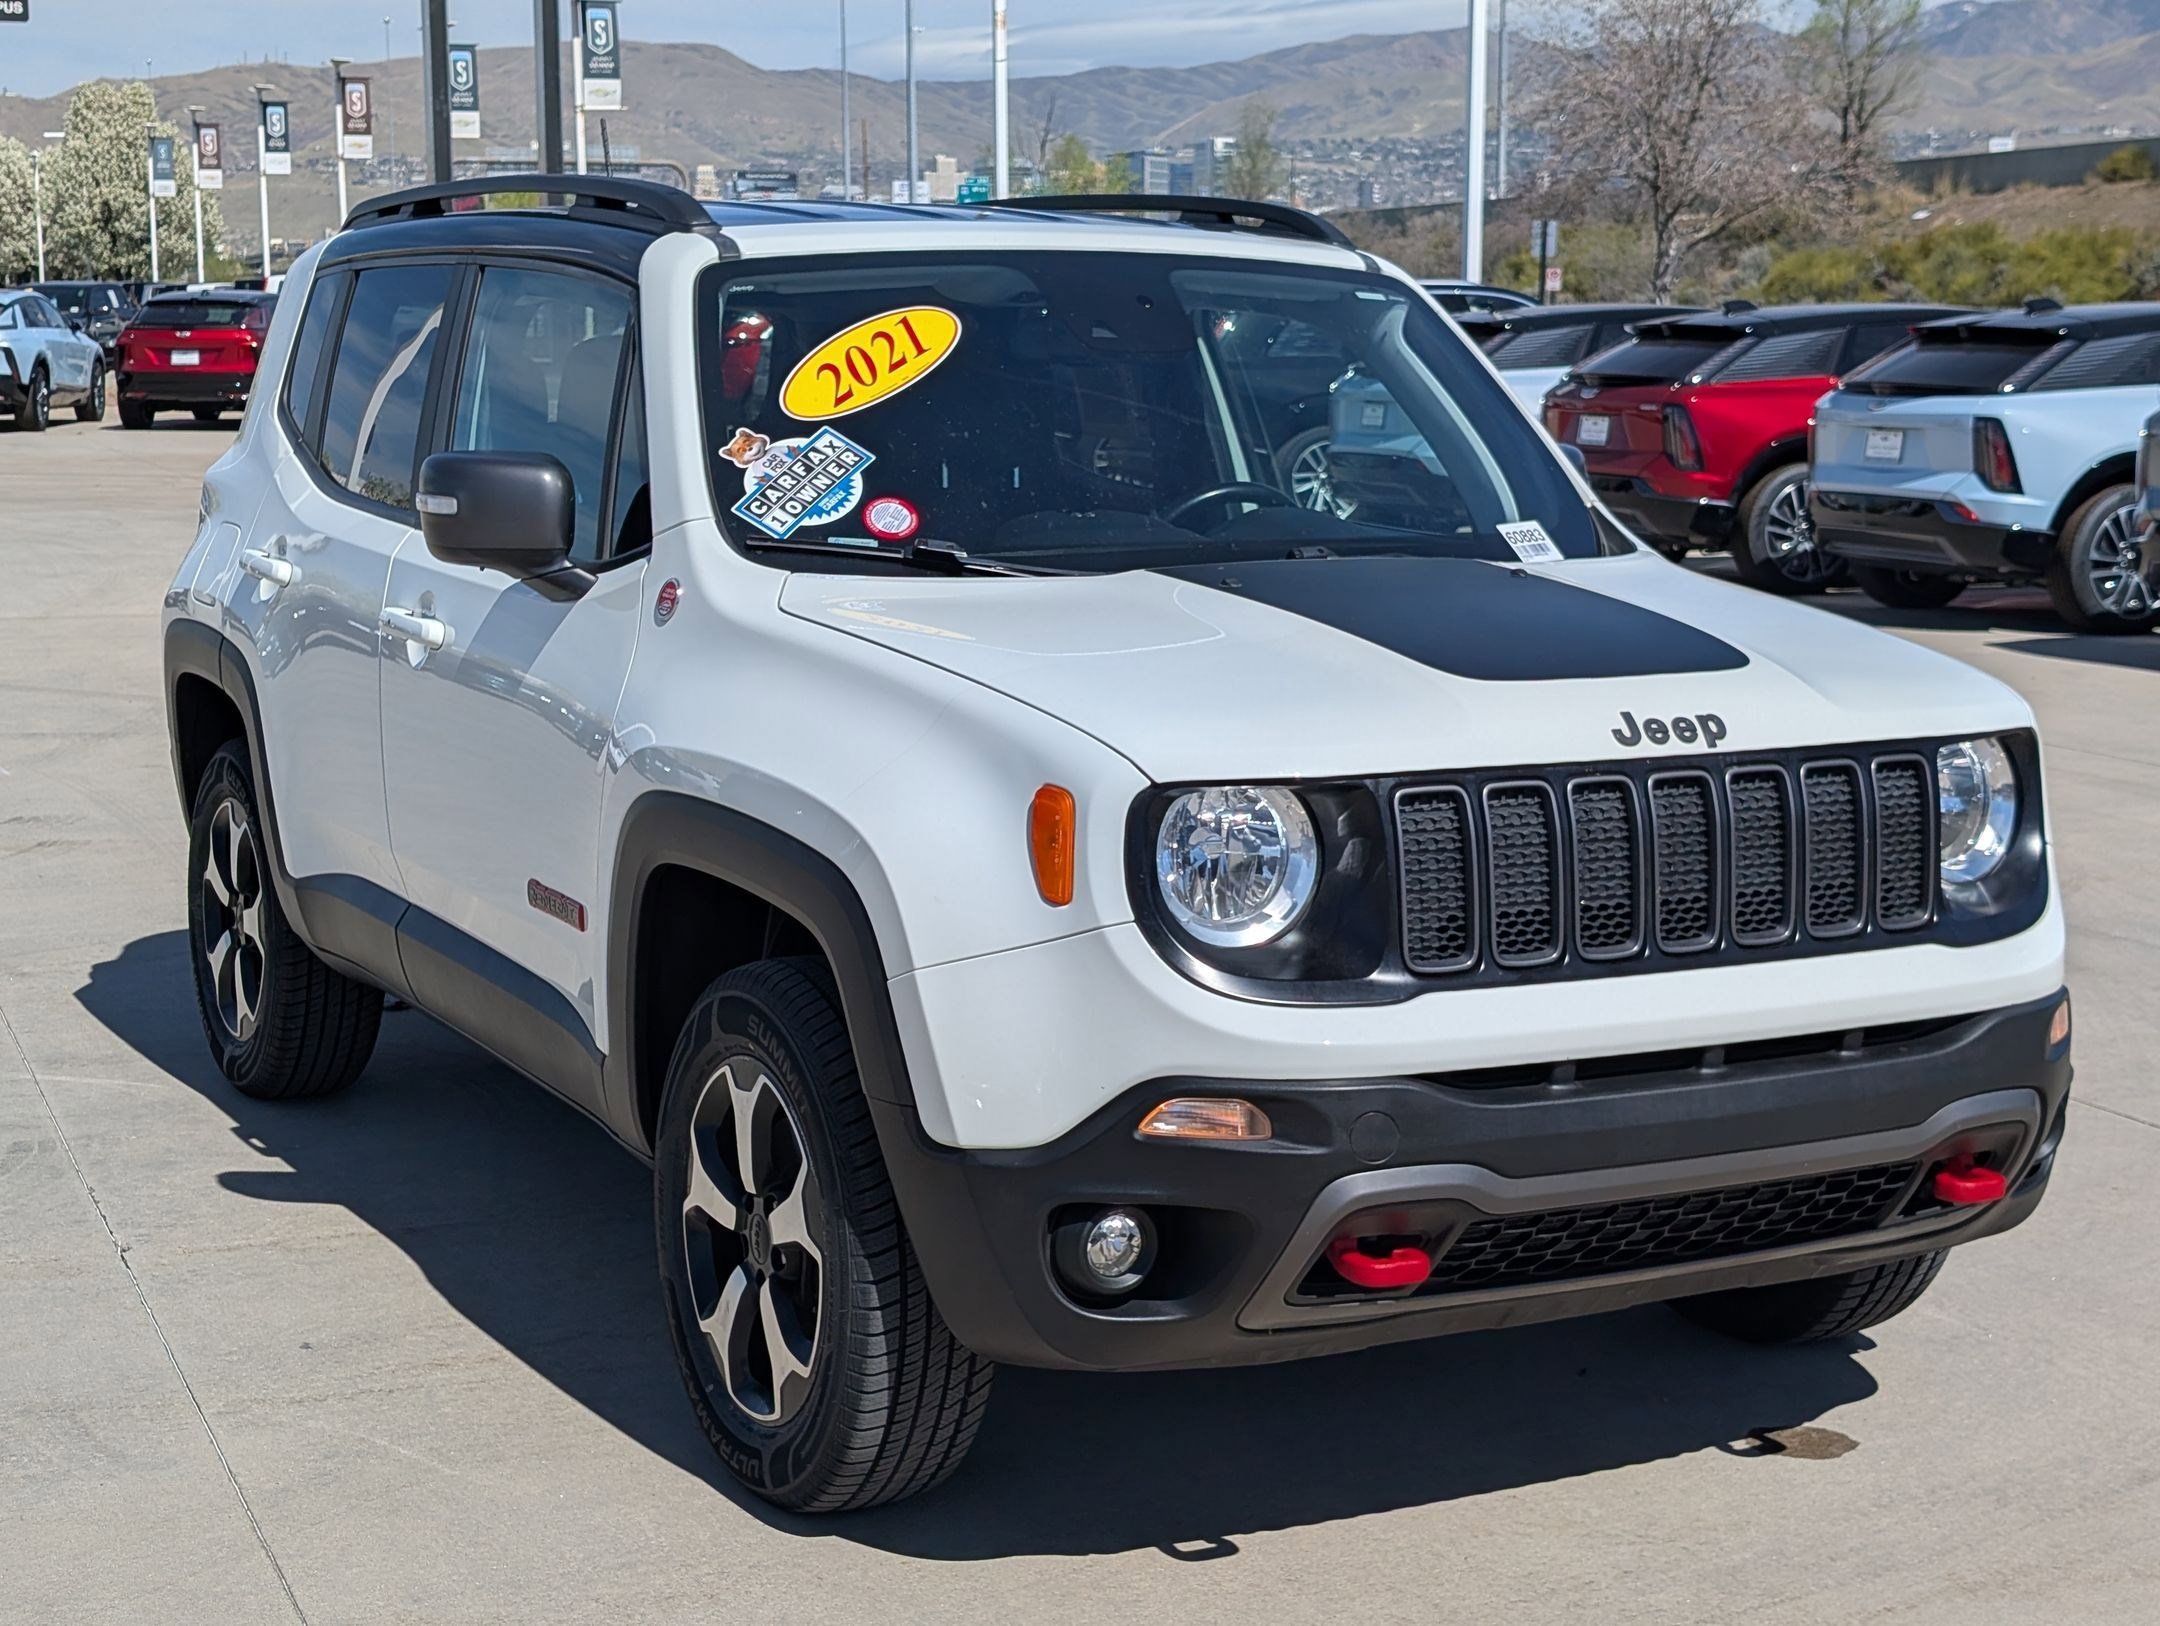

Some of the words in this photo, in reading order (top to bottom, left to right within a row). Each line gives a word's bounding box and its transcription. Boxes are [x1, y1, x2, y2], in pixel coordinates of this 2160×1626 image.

[816, 316, 932, 408] 2021
[750, 440, 841, 515] CARFAX
[762, 453, 780, 469] CAR
[771, 460, 788, 473] FOX
[771, 515, 788, 528] 1
[785, 450, 860, 514] OWNER
[1505, 528, 1545, 545] 60883
[1611, 711, 1727, 749] Jeep
